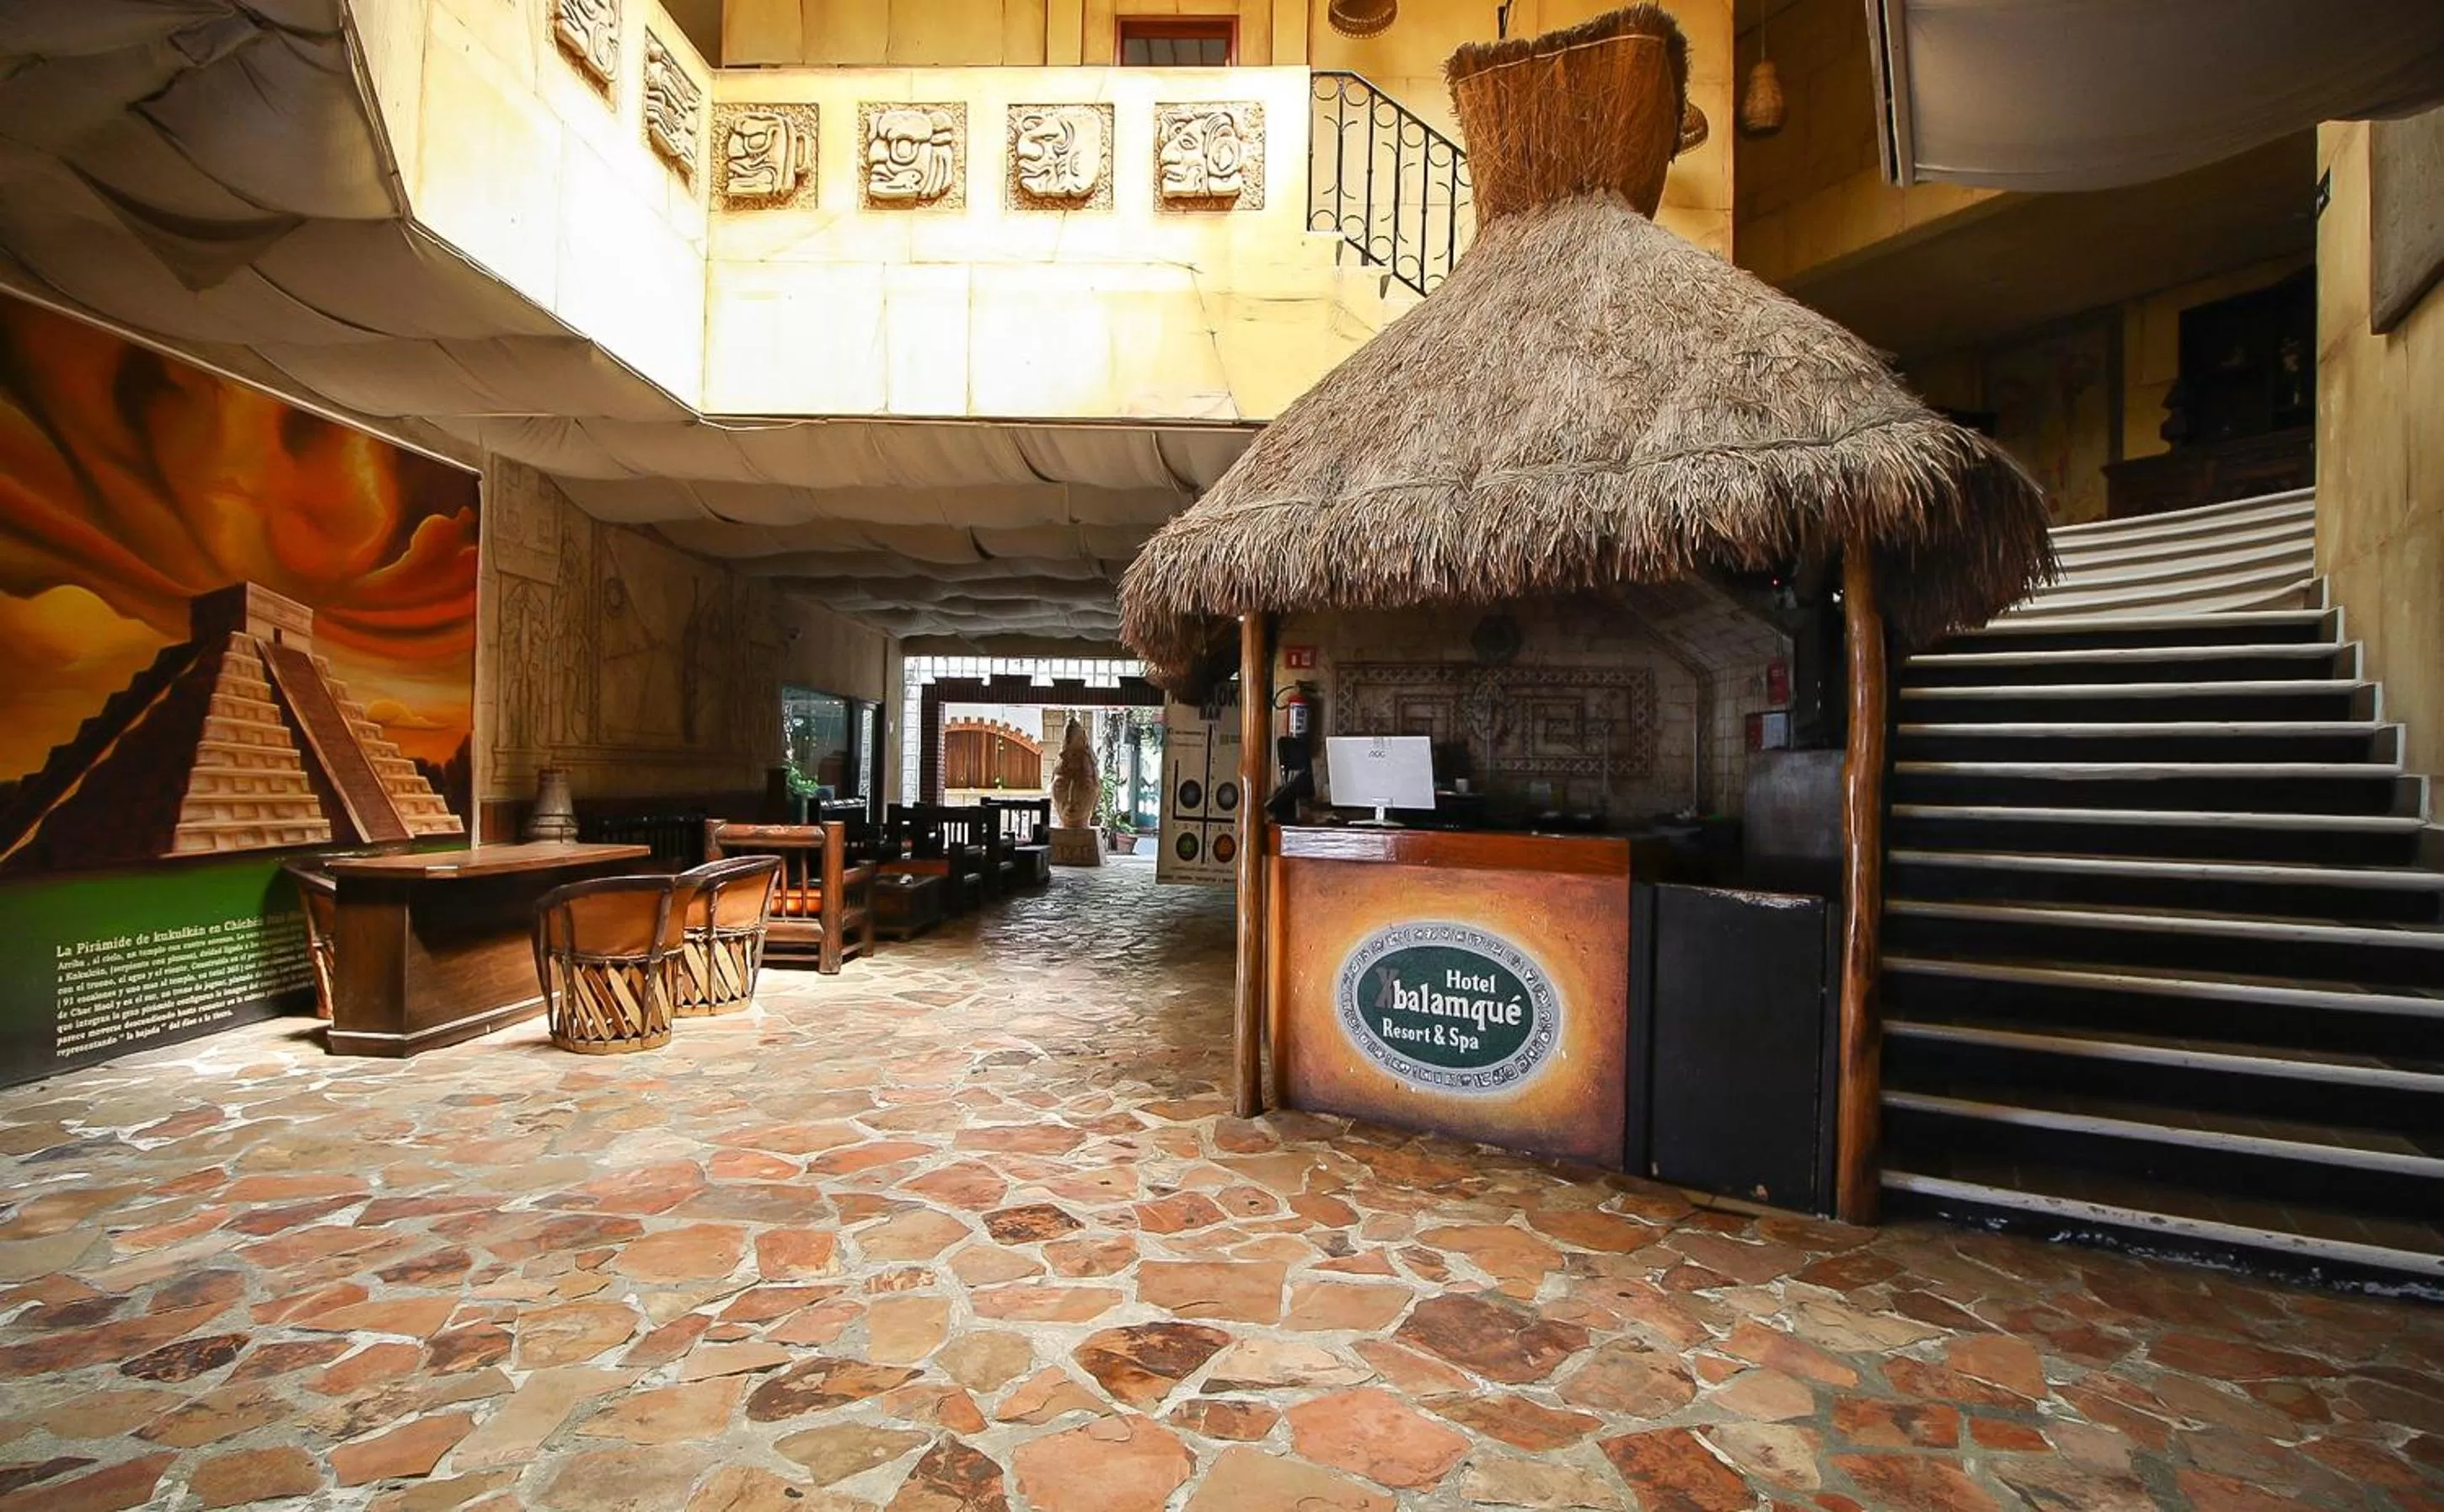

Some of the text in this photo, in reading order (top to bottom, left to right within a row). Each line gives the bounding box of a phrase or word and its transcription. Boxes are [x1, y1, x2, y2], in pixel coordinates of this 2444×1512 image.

[1368, 750, 1386, 759] AOC
[136, 934, 149, 945] de
[1445, 970, 1497, 994] Hotel
[1382, 1018, 1480, 1054] Resort & Spa
